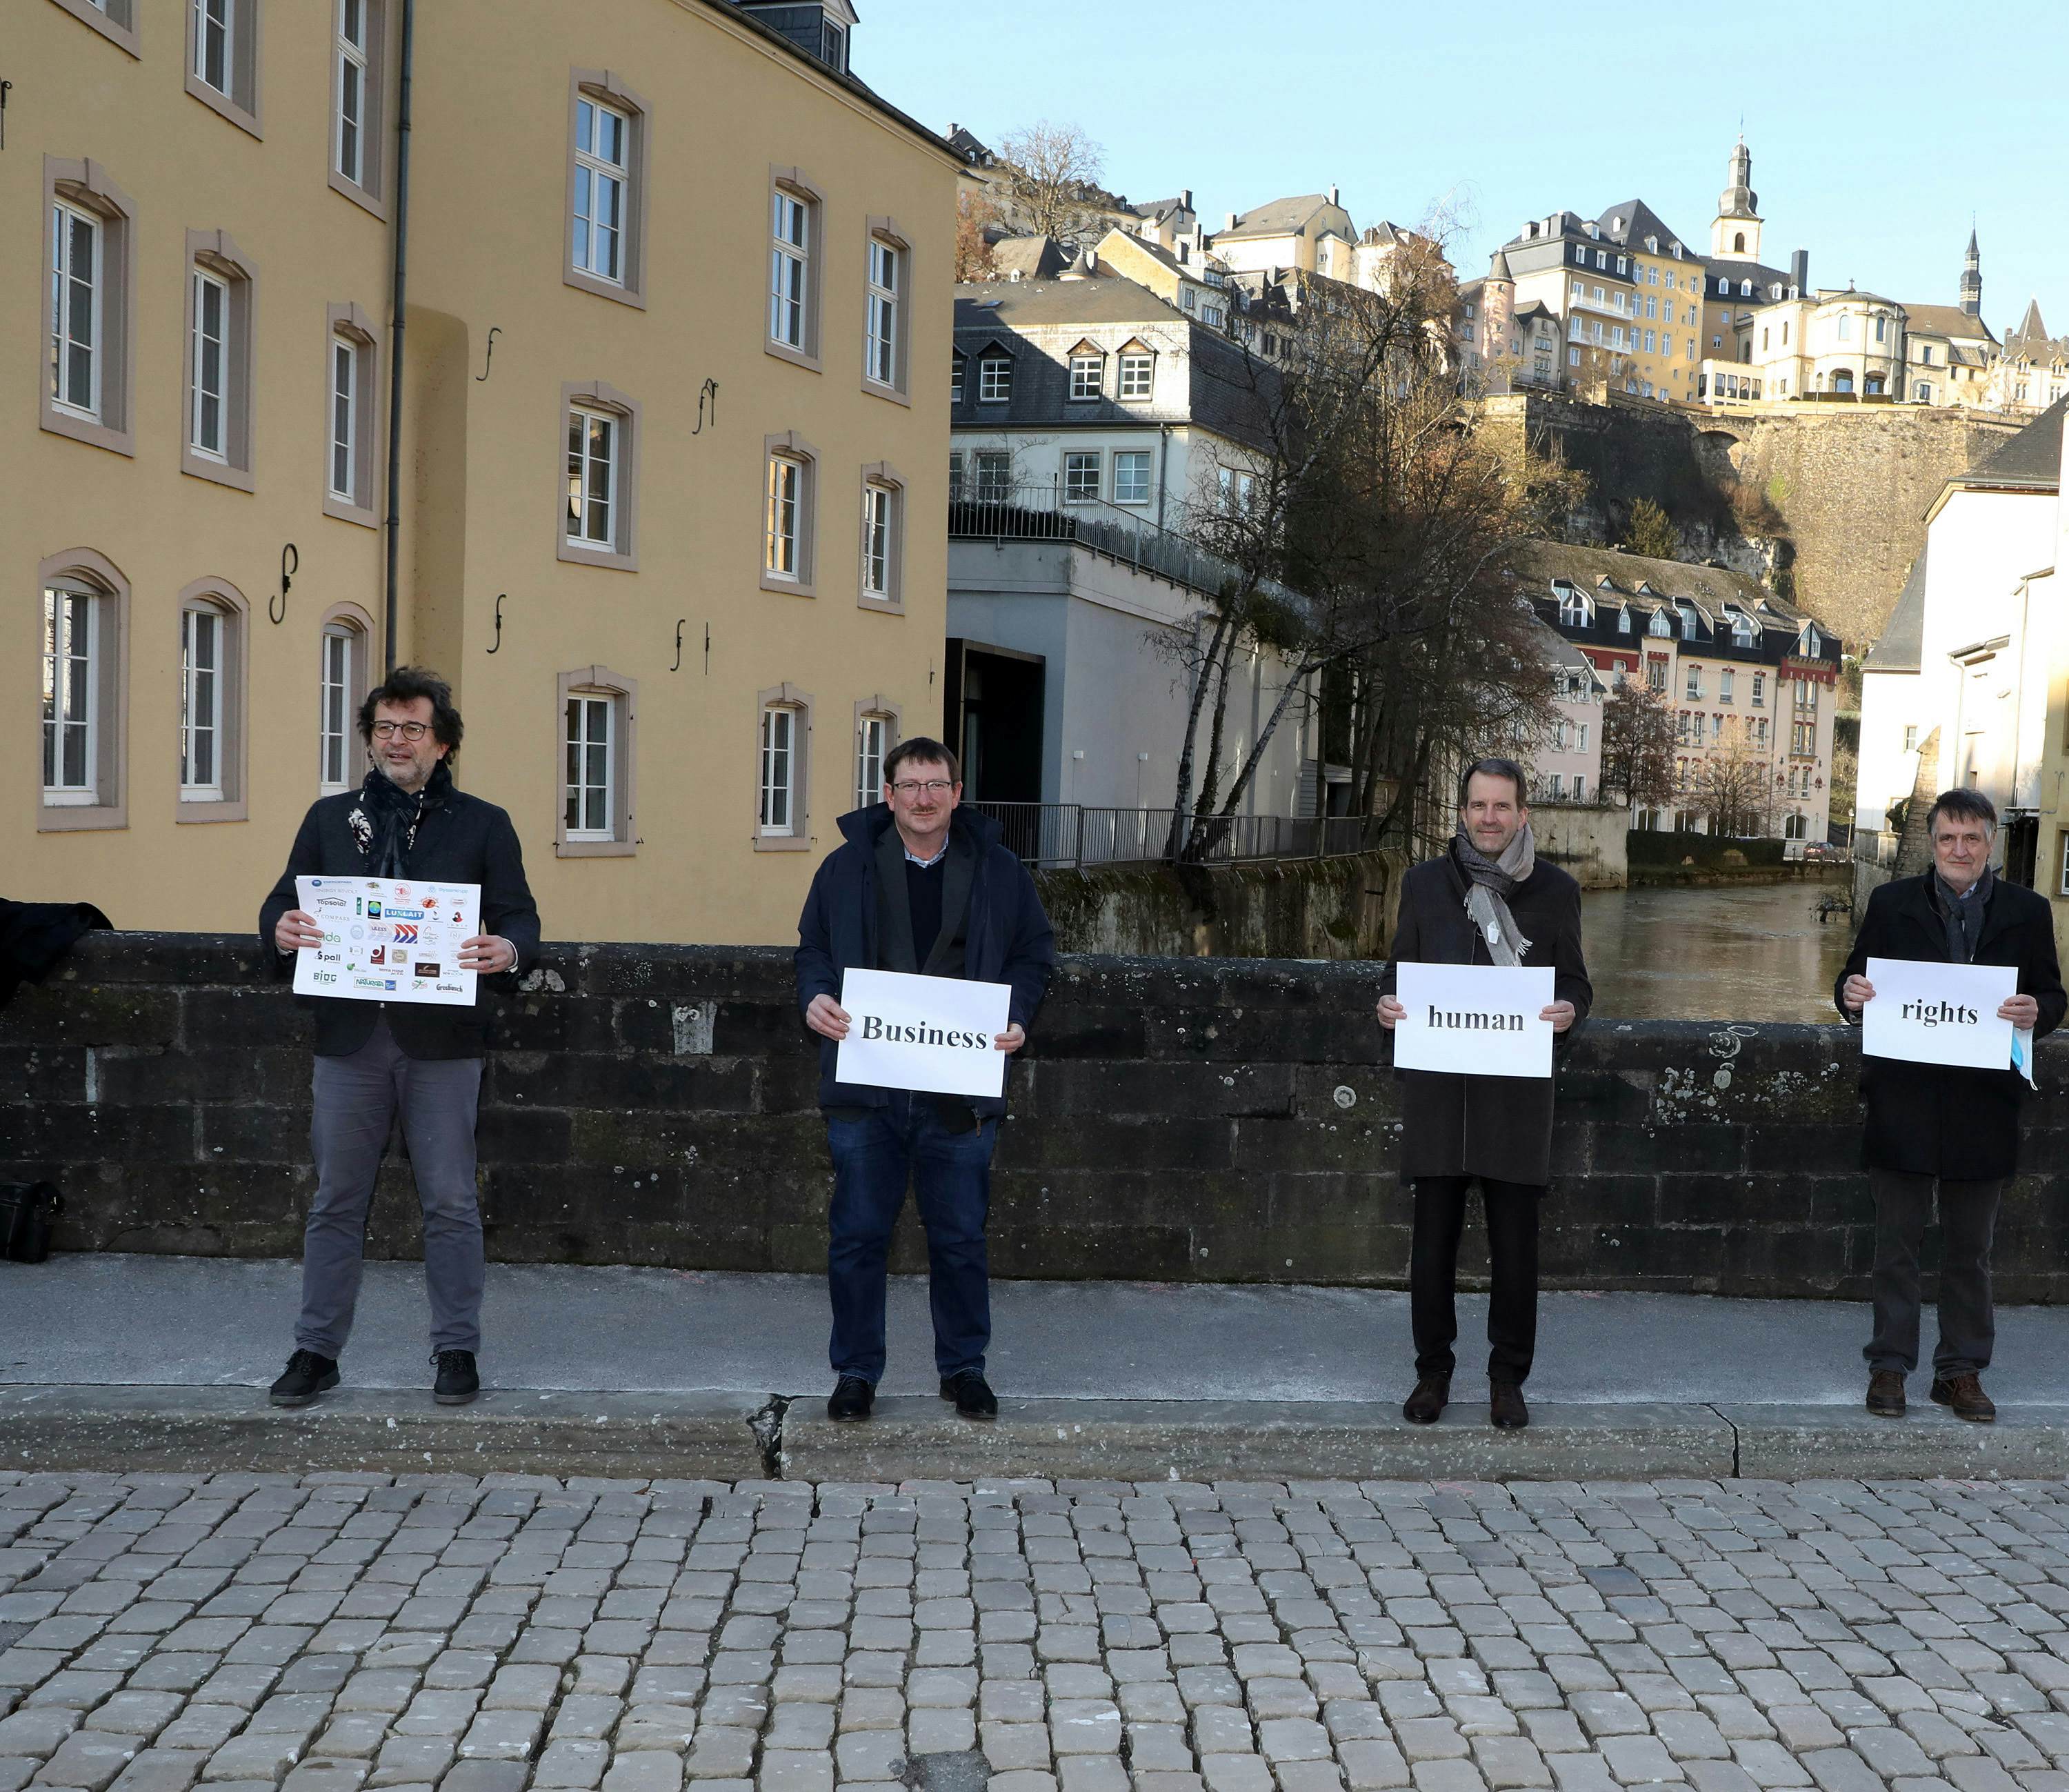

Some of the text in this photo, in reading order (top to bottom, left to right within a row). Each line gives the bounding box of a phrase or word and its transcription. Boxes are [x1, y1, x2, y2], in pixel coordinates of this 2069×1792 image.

[386, 909, 423, 919] LUXLAIT
[1428, 1004, 1524, 1031] human
[1901, 999, 1978, 1028] rights
[861, 1015, 987, 1050] Business
